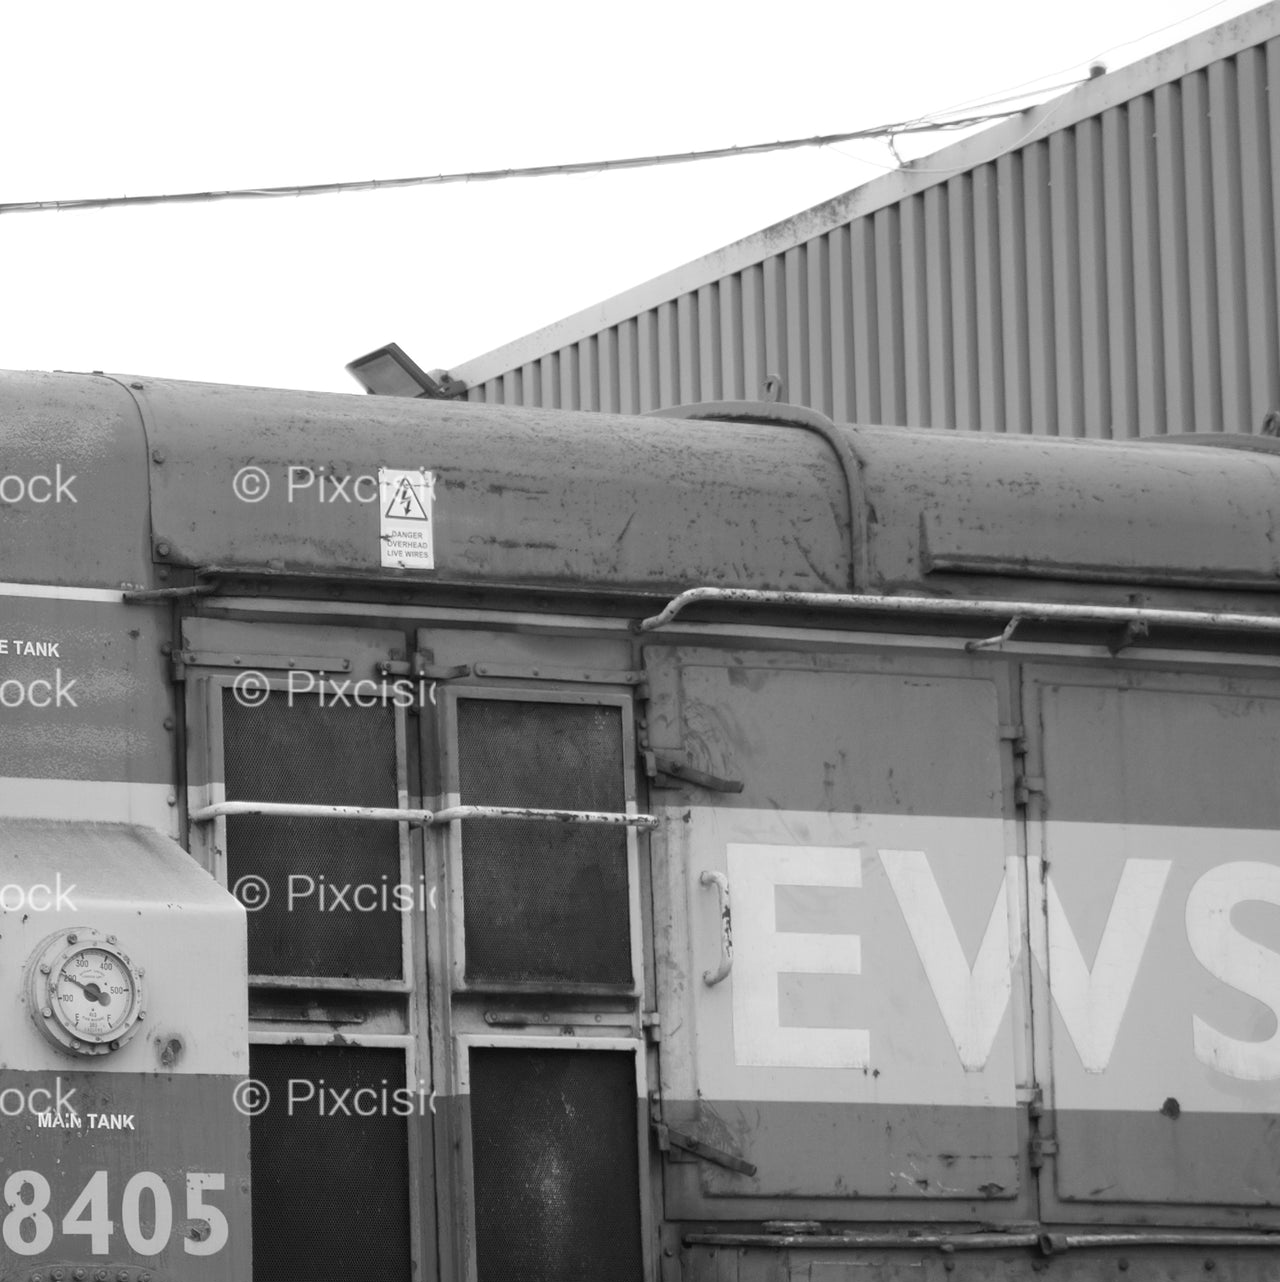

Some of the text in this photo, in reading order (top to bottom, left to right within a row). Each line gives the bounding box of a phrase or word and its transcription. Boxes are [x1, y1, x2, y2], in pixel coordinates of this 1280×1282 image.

[391, 530, 423, 540] DANGER
[387, 540, 428, 549] OVERHEAD
[386, 550, 429, 559] LIVE WIRES
[13, 640, 60, 658] TANK
[76, 960, 89, 968] 300
[726, 843, 1280, 1081] EWS
[100, 963, 113, 971] 400
[110, 986, 124, 994] 500
[62, 994, 74, 1002] 100
[37, 1113, 135, 1130] MAIN TANK
